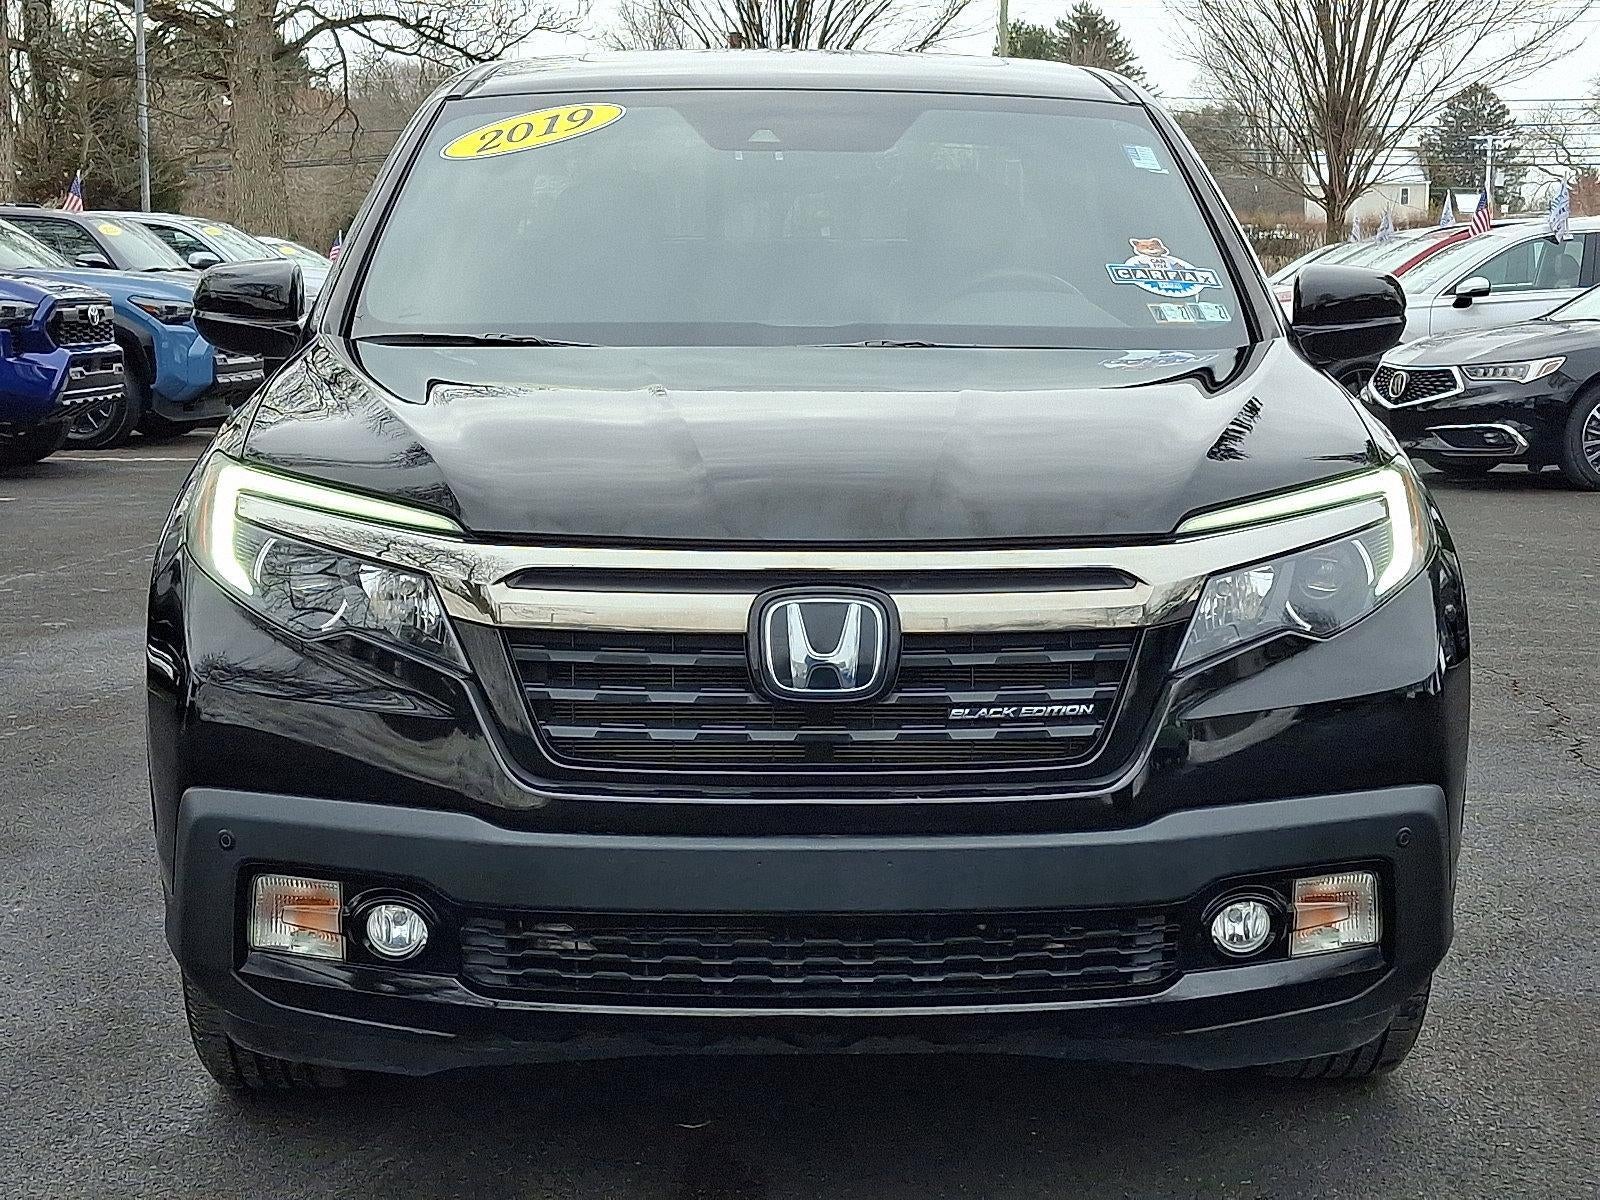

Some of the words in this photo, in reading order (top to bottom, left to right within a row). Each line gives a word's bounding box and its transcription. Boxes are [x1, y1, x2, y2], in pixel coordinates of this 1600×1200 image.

[476, 108, 594, 153] 2019
[1116, 268, 1212, 284] CARFAX
[949, 706, 1018, 720] BLACK
[1018, 704, 1095, 718] EDITION
